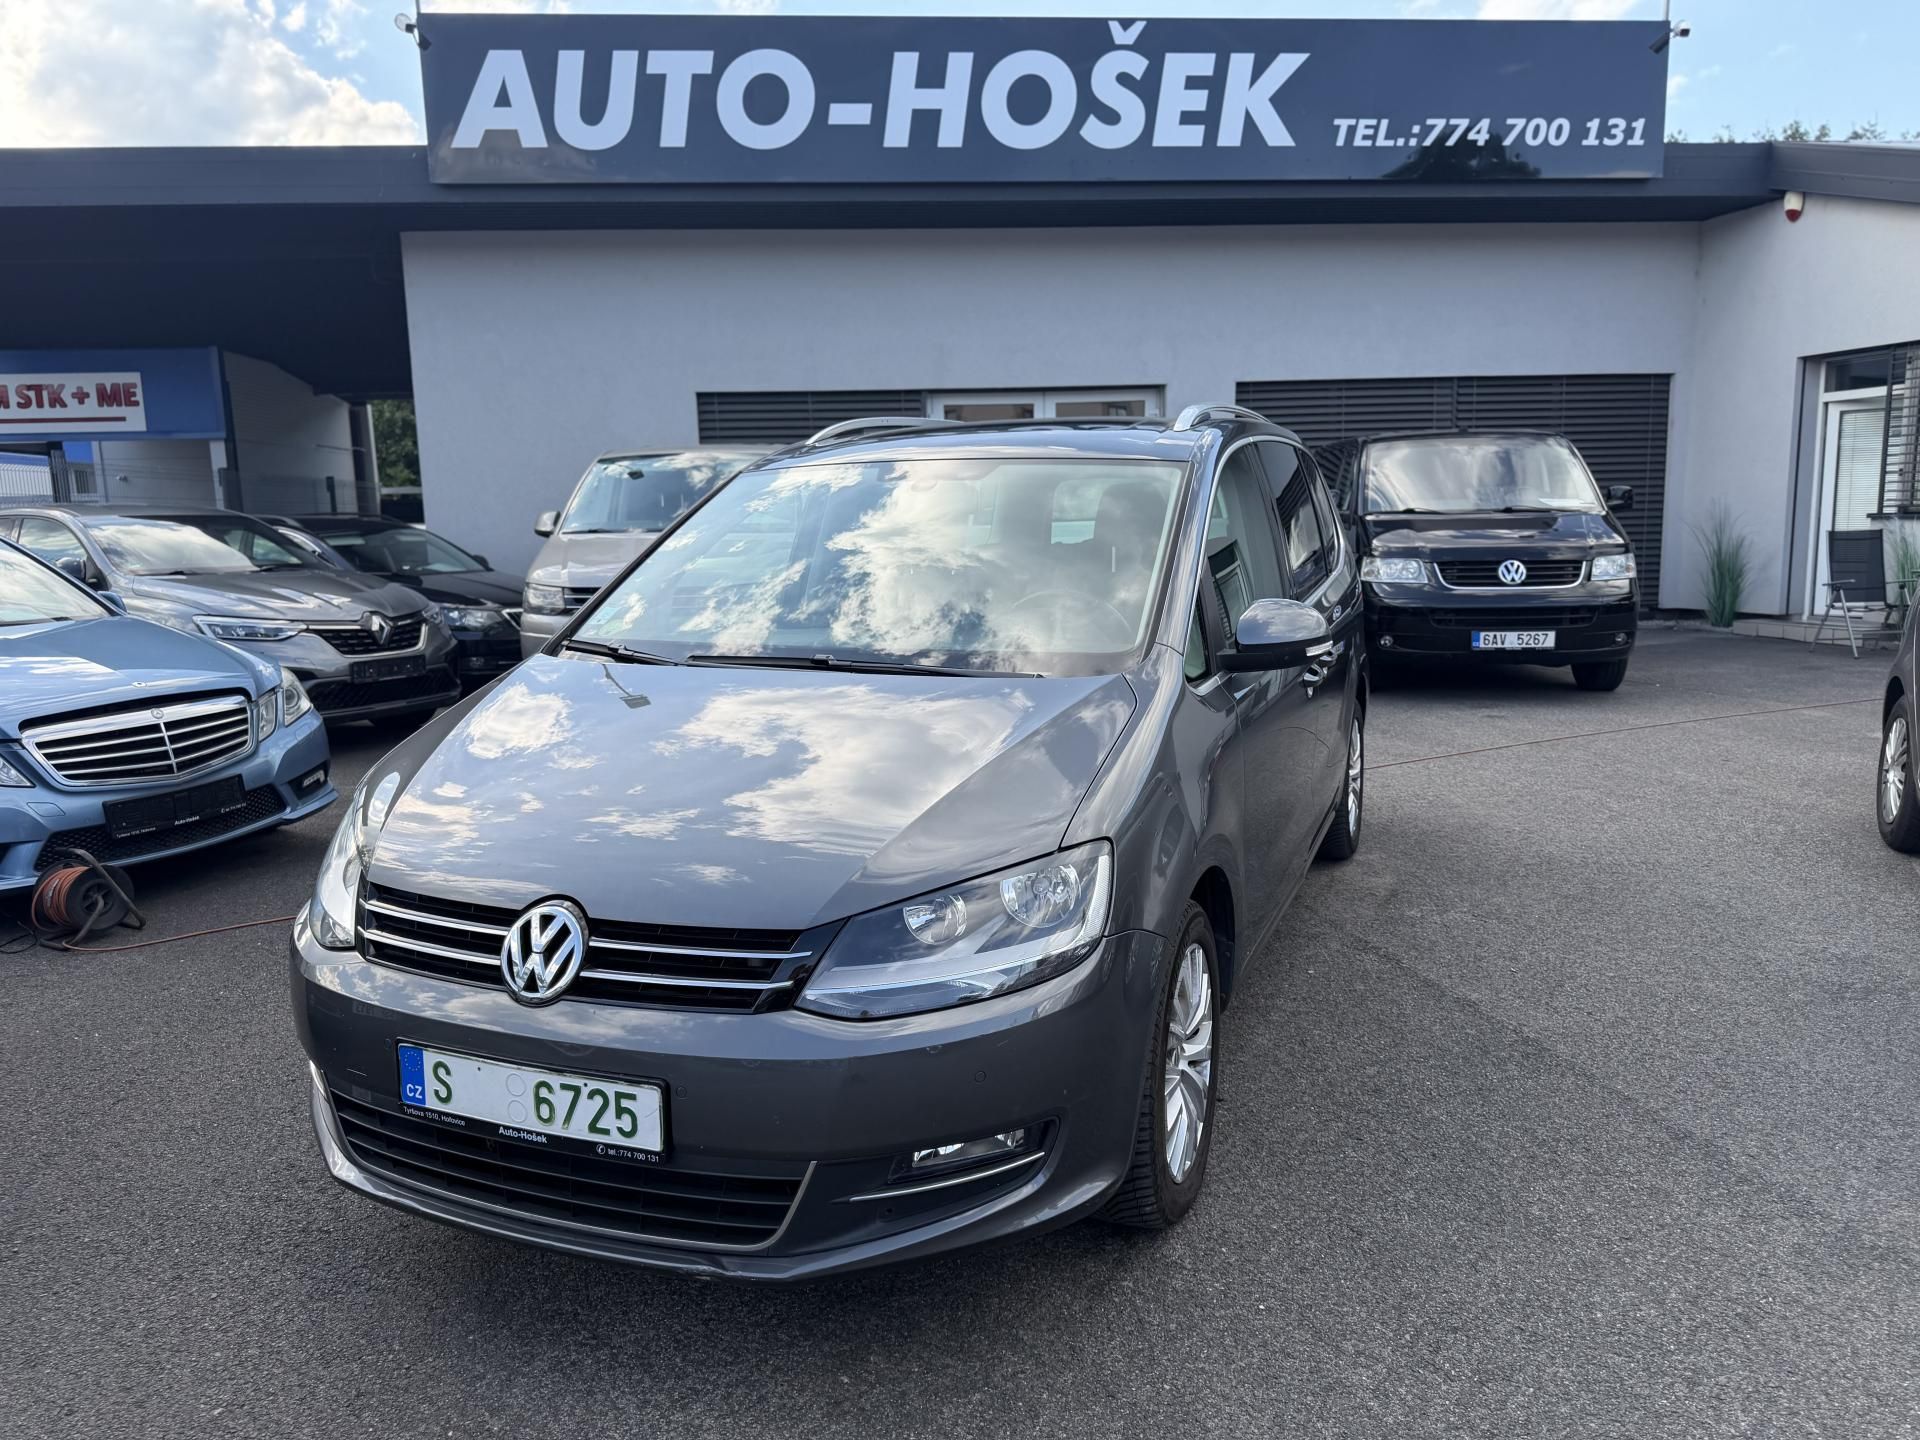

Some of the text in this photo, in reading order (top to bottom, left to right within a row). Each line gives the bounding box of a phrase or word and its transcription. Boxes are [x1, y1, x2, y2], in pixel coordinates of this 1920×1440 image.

[450, 20, 1311, 151] AUTO-HOŠEK
[1333, 117, 1646, 147] TEL.:774 700 131
[15, 383, 68, 409] STK
[95, 382, 140, 408] ME
[1483, 633, 1549, 646] 6AV 5267
[406, 1083, 423, 1099] CZ
[432, 1060, 639, 1139] S 6725
[499, 1126, 548, 1144] Auto-Hošek
